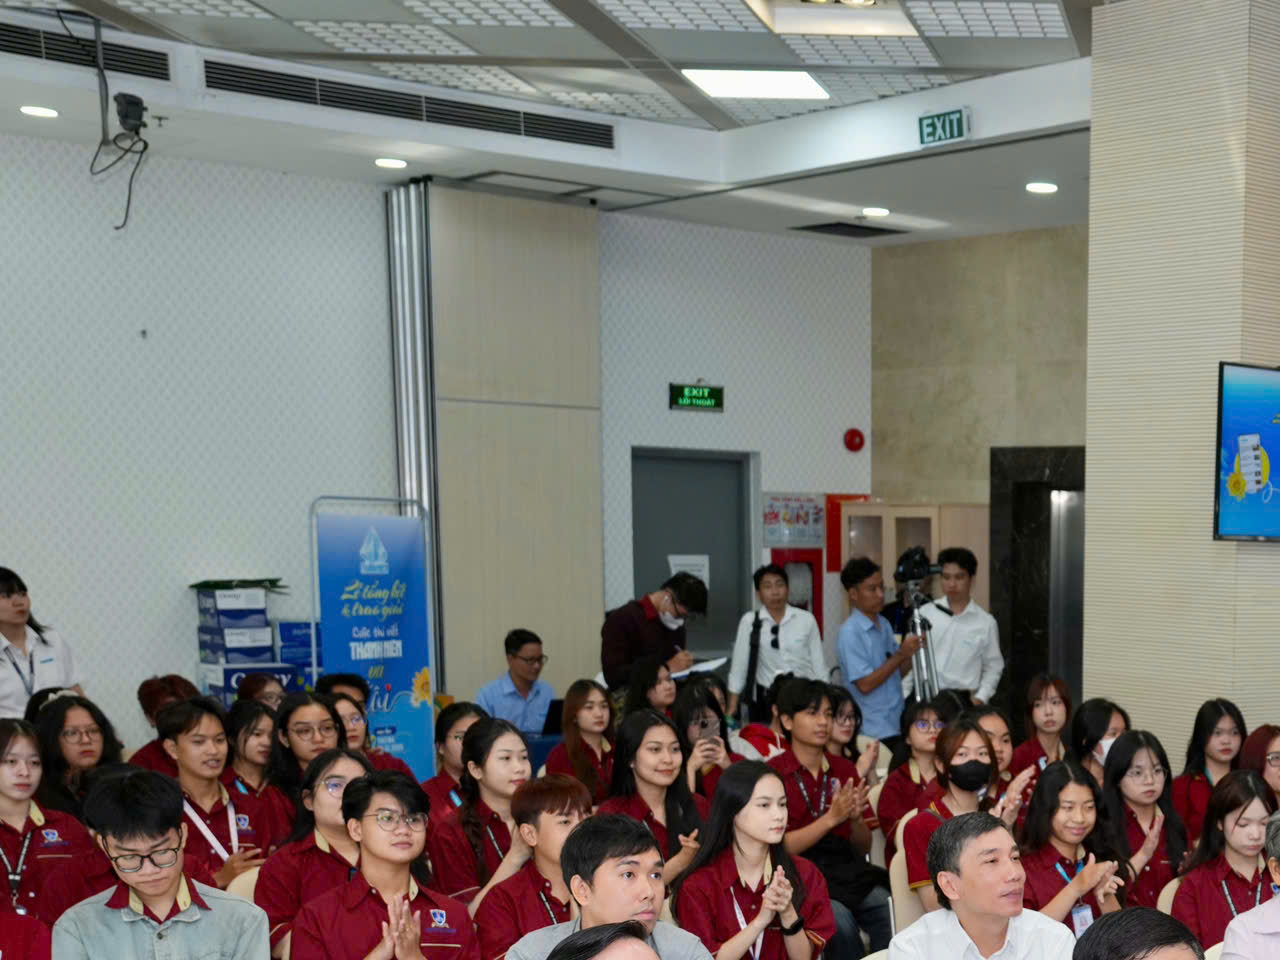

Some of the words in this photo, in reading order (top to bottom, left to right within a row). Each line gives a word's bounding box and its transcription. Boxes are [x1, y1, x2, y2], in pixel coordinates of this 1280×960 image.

[922, 112, 960, 143] EXIT
[684, 387, 710, 397] EXIT
[349, 640, 383, 661] THANH
